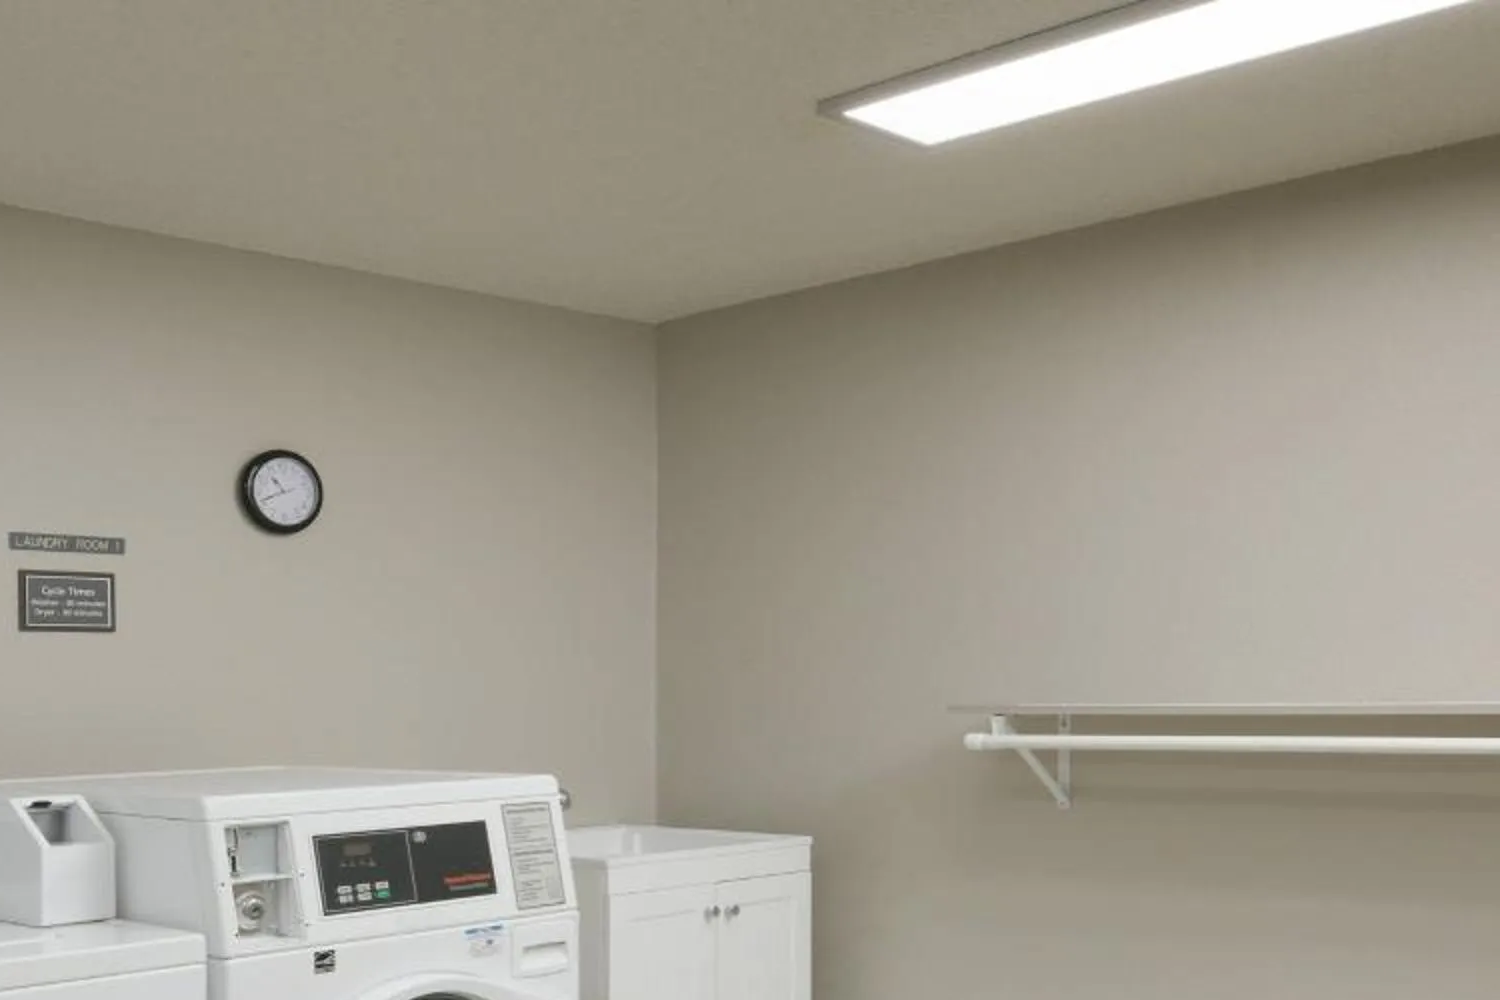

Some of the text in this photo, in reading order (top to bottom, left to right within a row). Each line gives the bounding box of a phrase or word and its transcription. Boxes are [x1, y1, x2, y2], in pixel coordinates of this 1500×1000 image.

[15, 535, 68, 549] LAUNDRY
[76, 538, 109, 551] ROOM
[68, 586, 96, 597] Times
